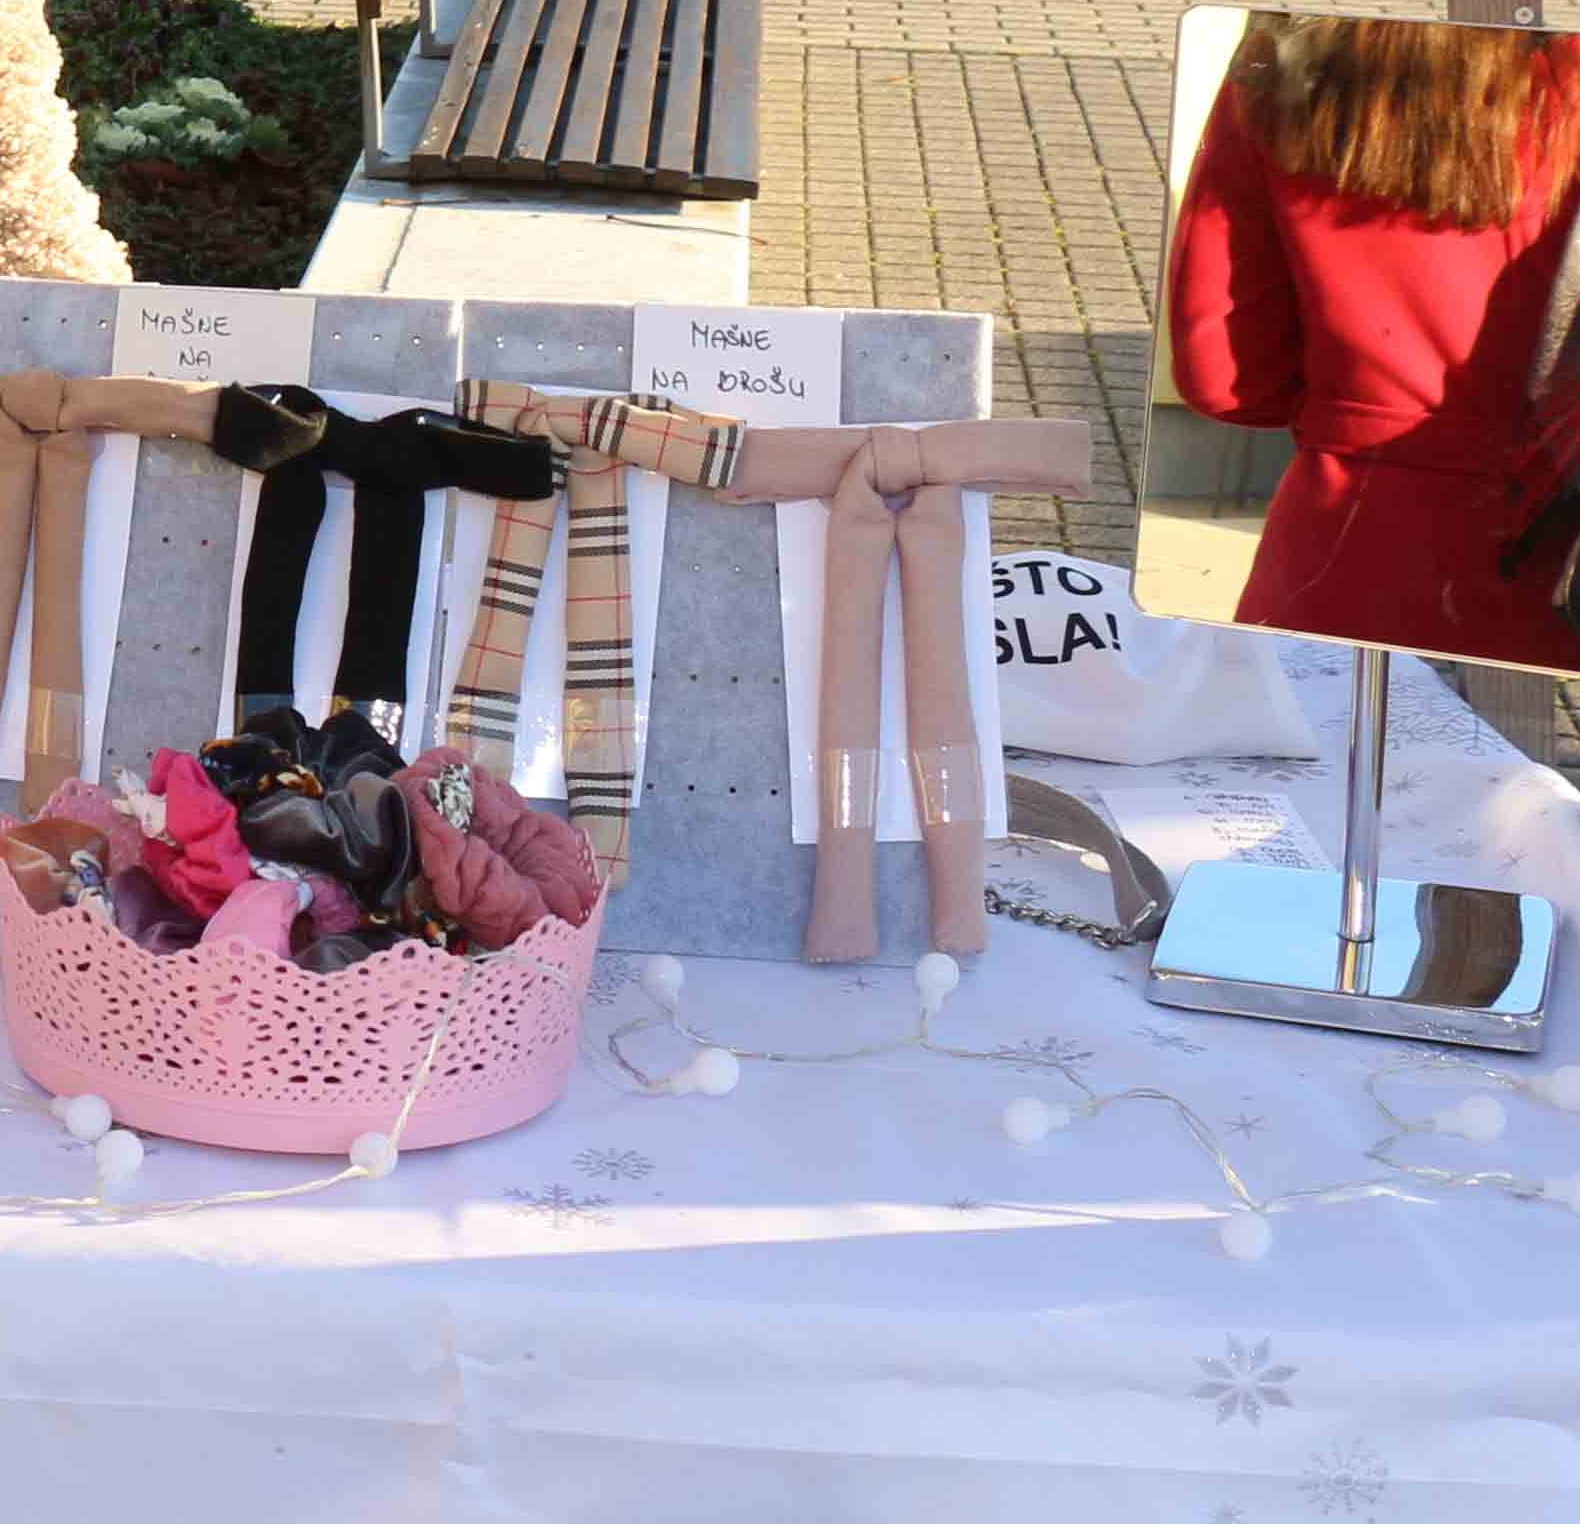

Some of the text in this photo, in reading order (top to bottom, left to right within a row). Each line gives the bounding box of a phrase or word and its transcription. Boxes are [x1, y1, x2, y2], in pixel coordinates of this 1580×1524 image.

[141, 307, 232, 337] MAŠNE
[691, 321, 770, 351] MAŠNE
[178, 347, 211, 367] NA
[652, 366, 689, 391] NA
